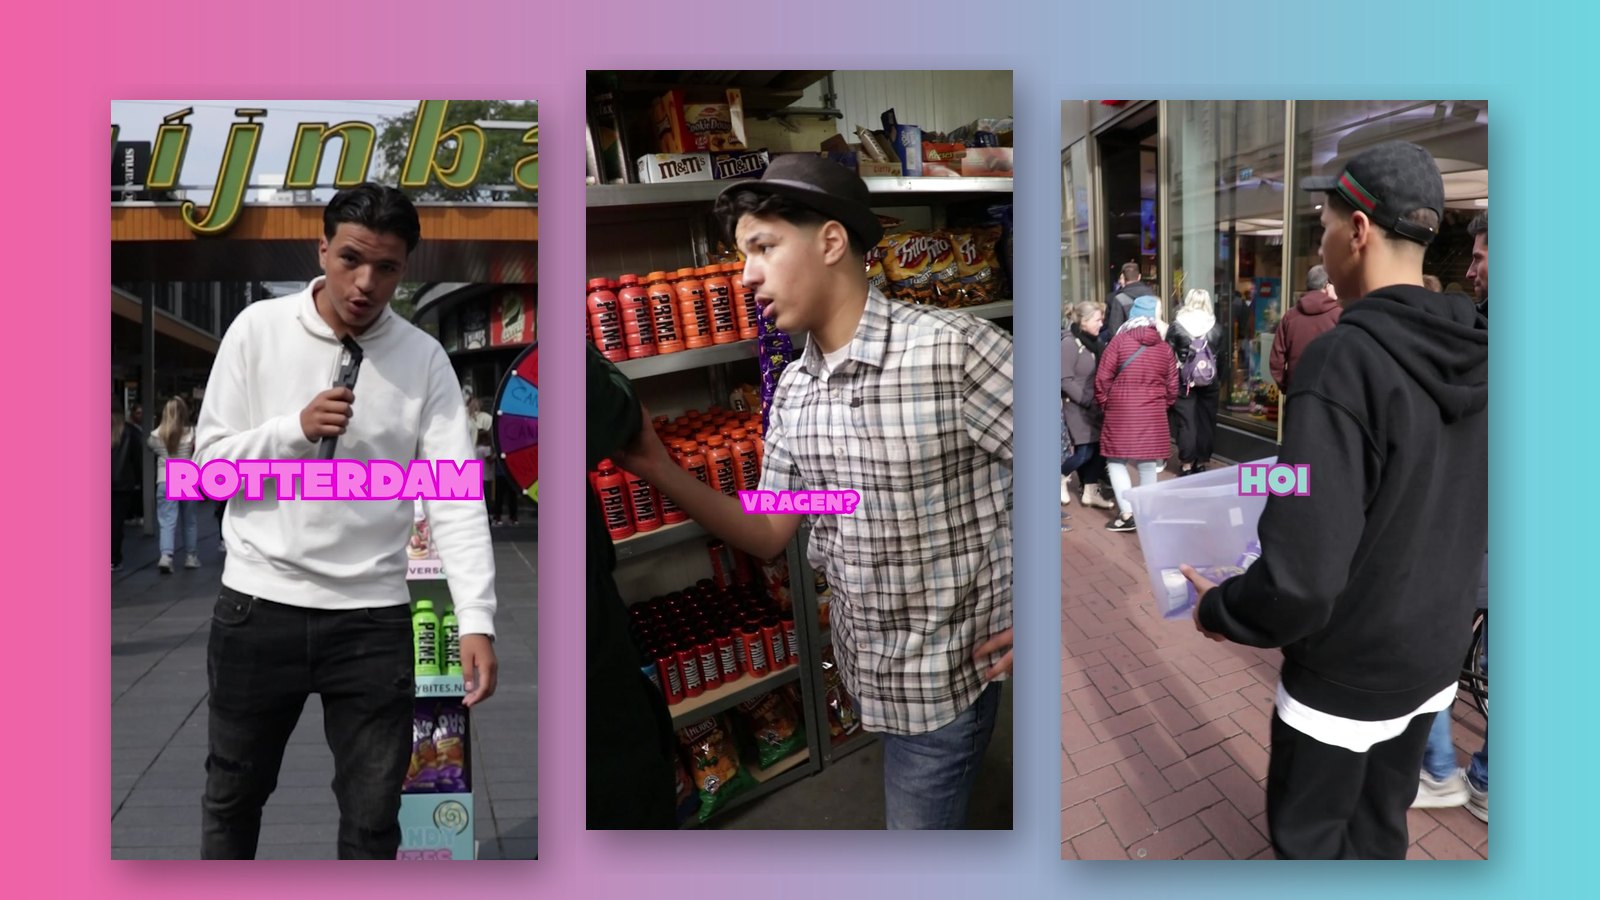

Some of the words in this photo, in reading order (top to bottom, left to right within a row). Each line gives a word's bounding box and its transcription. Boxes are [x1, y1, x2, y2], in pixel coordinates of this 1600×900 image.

[121, 147, 136, 190] varius
[597, 301, 622, 351] PRIME
[652, 294, 677, 343] PRIME
[710, 286, 733, 333] PRIME
[742, 285, 757, 328] RIME
[602, 486, 628, 530] PRIME
[419, 622, 436, 665] PRIME
[416, 683, 468, 693] YBITES.NL
[404, 827, 456, 847] NDY
